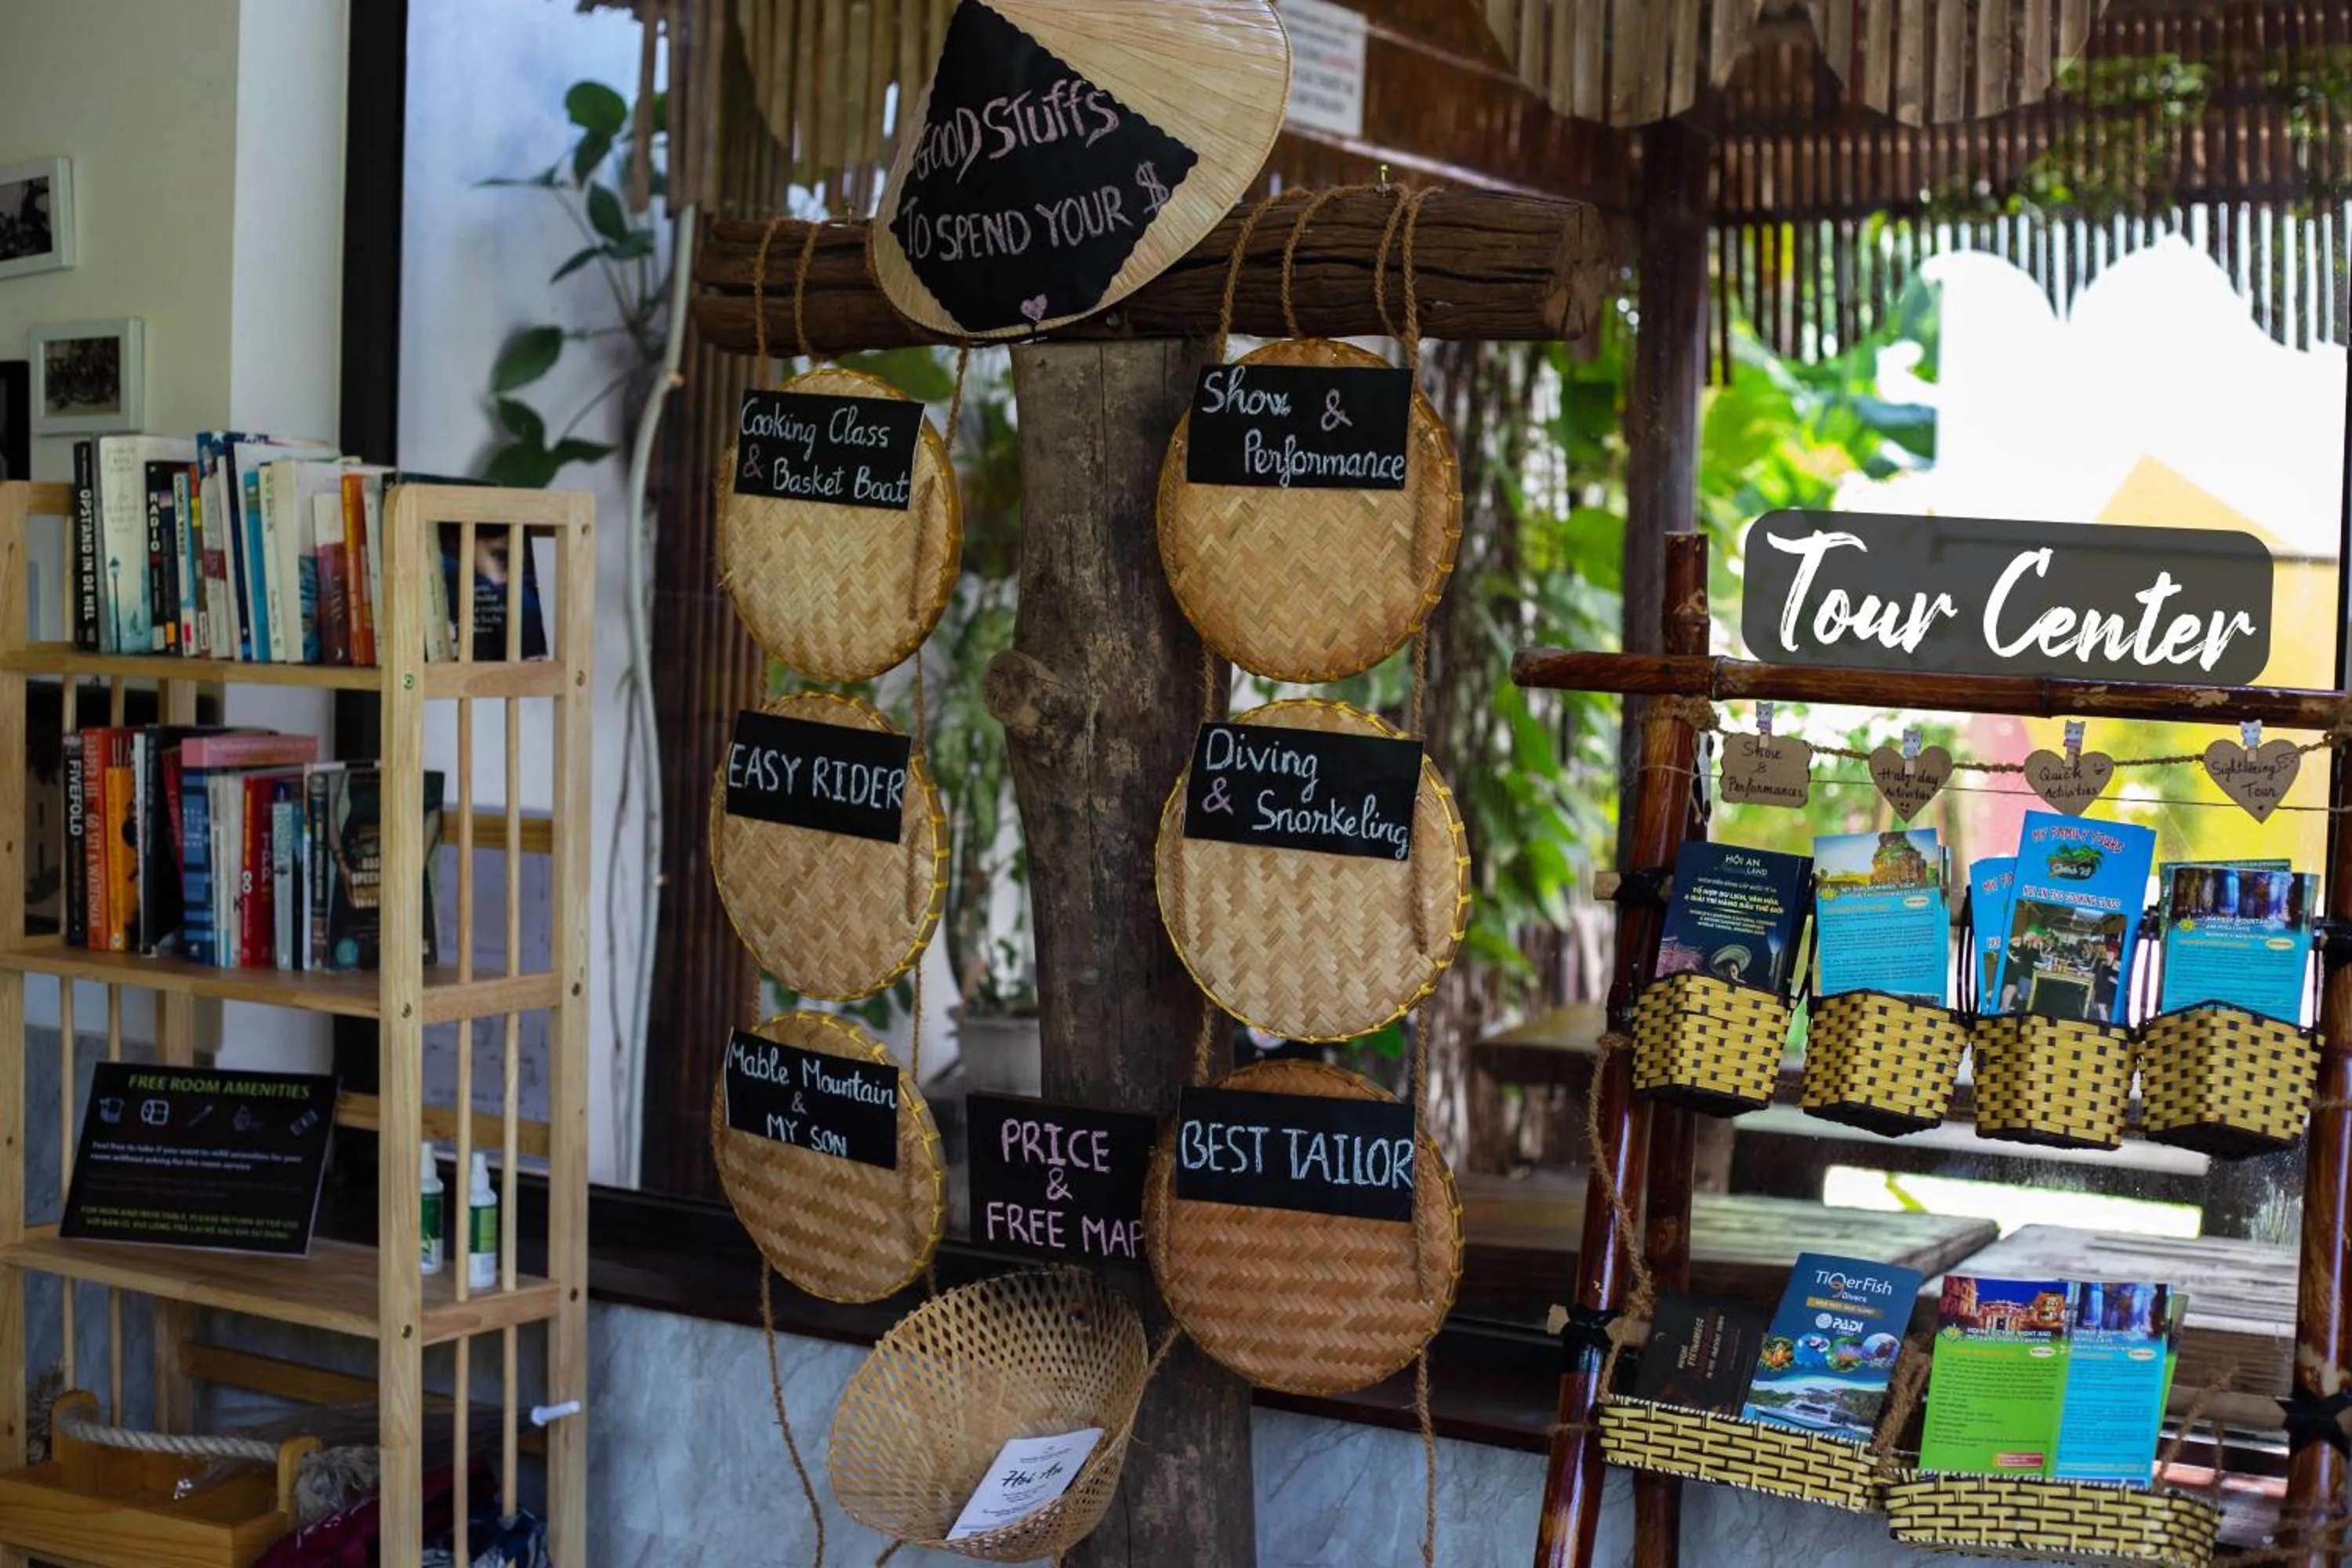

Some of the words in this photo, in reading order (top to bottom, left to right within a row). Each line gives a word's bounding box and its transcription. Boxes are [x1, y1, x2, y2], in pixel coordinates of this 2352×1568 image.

[916, 107, 981, 183] GOOD
[902, 197, 931, 260] TO
[940, 210, 1032, 261] SPEND
[1035, 186, 1133, 247] YOUR
[1136, 162, 1168, 214] $
[1202, 365, 1293, 417] Show
[1320, 389, 1353, 431] &
[741, 397, 816, 462] Cooking
[829, 405, 891, 448] Class
[1244, 428, 1406, 488] Performance
[742, 443, 764, 480] &
[773, 457, 845, 496] Basket
[854, 466, 910, 503] Boat
[80, 489, 94, 554] OPSTAND
[150, 492, 160, 552] RADIO
[82, 557, 94, 572] IN
[82, 575, 95, 591] DE
[84, 595, 96, 621] HEL
[1766, 530, 1958, 652] Tour
[1983, 546, 2256, 672] Center
[728, 744, 802, 795] EASY
[812, 757, 906, 810] RIDER
[1206, 728, 1319, 804] Diving
[68, 759, 83, 836] FIVEFOLD
[1201, 777, 1234, 815] &
[1252, 789, 1410, 860] Snorkeling
[1745, 858, 1761, 867] AN
[2050, 826, 2090, 842] FAMILY
[129, 1074, 169, 1090] FREE
[170, 1076, 220, 1094] ROOM
[223, 1080, 310, 1099] AMENITIES
[728, 1044, 789, 1085] Mable
[802, 1058, 897, 1109] Mountain
[792, 1091, 808, 1116] &
[767, 1112, 798, 1142] MY
[811, 1126, 847, 1156] SON
[1001, 1119, 1112, 1174] PRICE
[1181, 1120, 1270, 1174] BEST
[1282, 1127, 1414, 1190] TAILOR
[1046, 1167, 1073, 1202] &
[986, 1202, 1067, 1250] FREE
[1081, 1214, 1145, 1258] MAP
[1832, 1318, 1864, 1333] PADI
